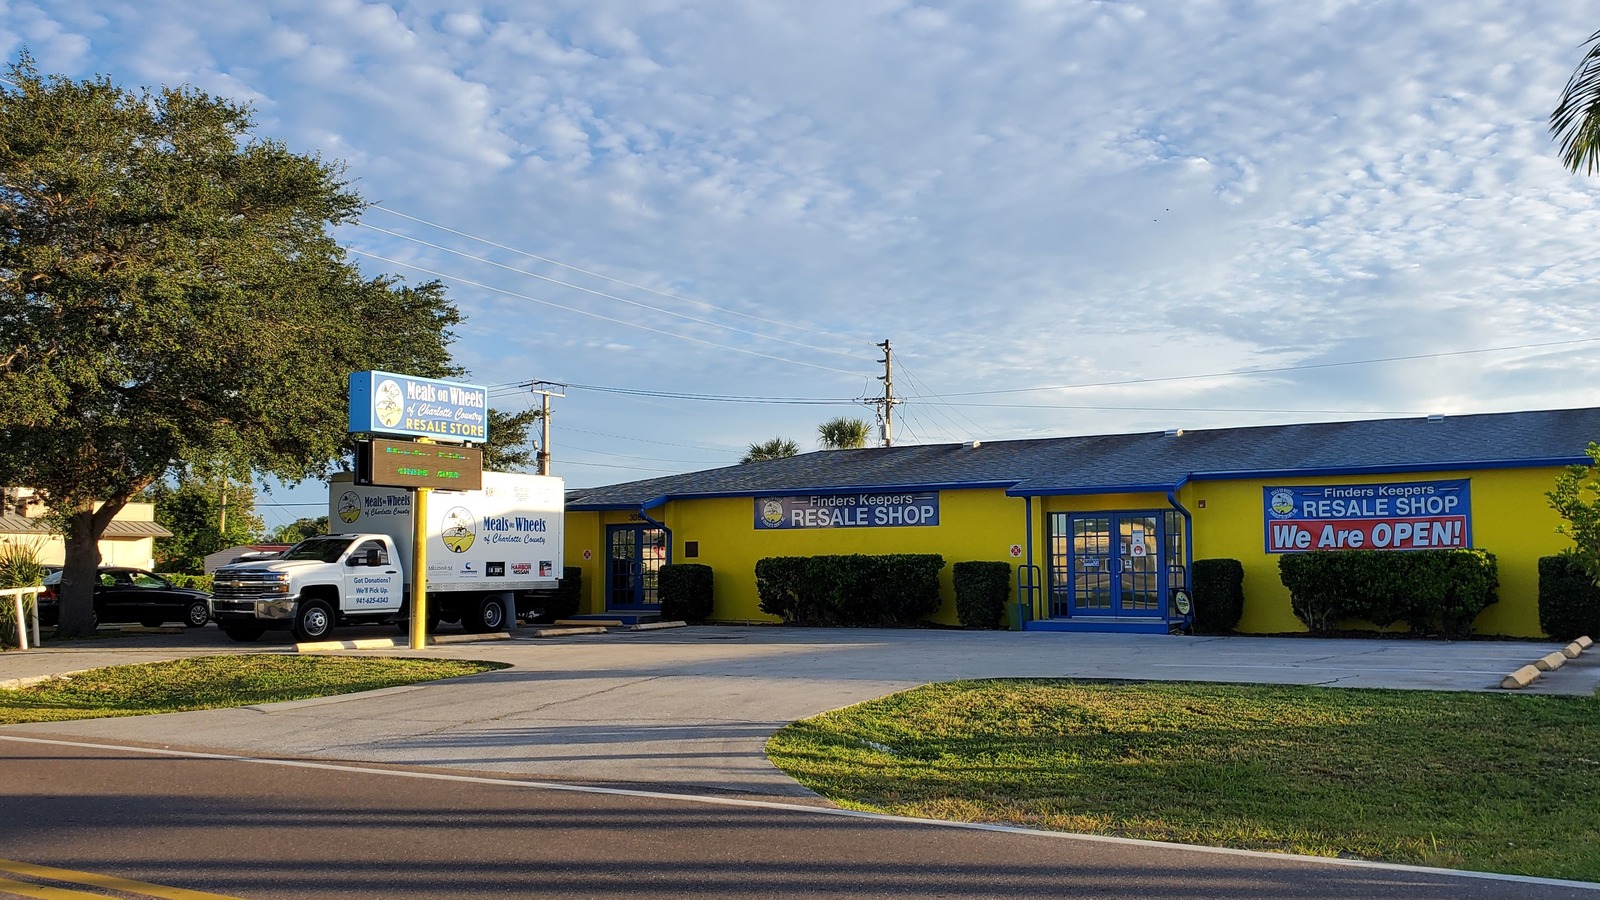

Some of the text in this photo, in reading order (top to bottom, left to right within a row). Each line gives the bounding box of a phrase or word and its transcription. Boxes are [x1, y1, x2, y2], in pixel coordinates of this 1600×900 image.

[407, 381, 484, 408] Meals on Wheels
[406, 403, 415, 416] of
[417, 403, 453, 419] Charlotte
[406, 417, 484, 437] RESALE STORE
[1324, 486, 1435, 498] Finders Keepers
[364, 496, 383, 507] Meals
[387, 495, 411, 506] Wheels
[810, 494, 913, 508] Finders Keepers
[1303, 499, 1389, 518] RESALE
[1395, 496, 1458, 515] SHOP
[371, 508, 392, 516] Charlotte
[791, 507, 869, 527] RESALE
[874, 505, 934, 525] SHOP
[483, 516, 509, 531] Meals
[515, 516, 546, 532] Wheels
[484, 533, 546, 545] of Charlotte County
[1273, 521, 1462, 549] We Are OPEN!
